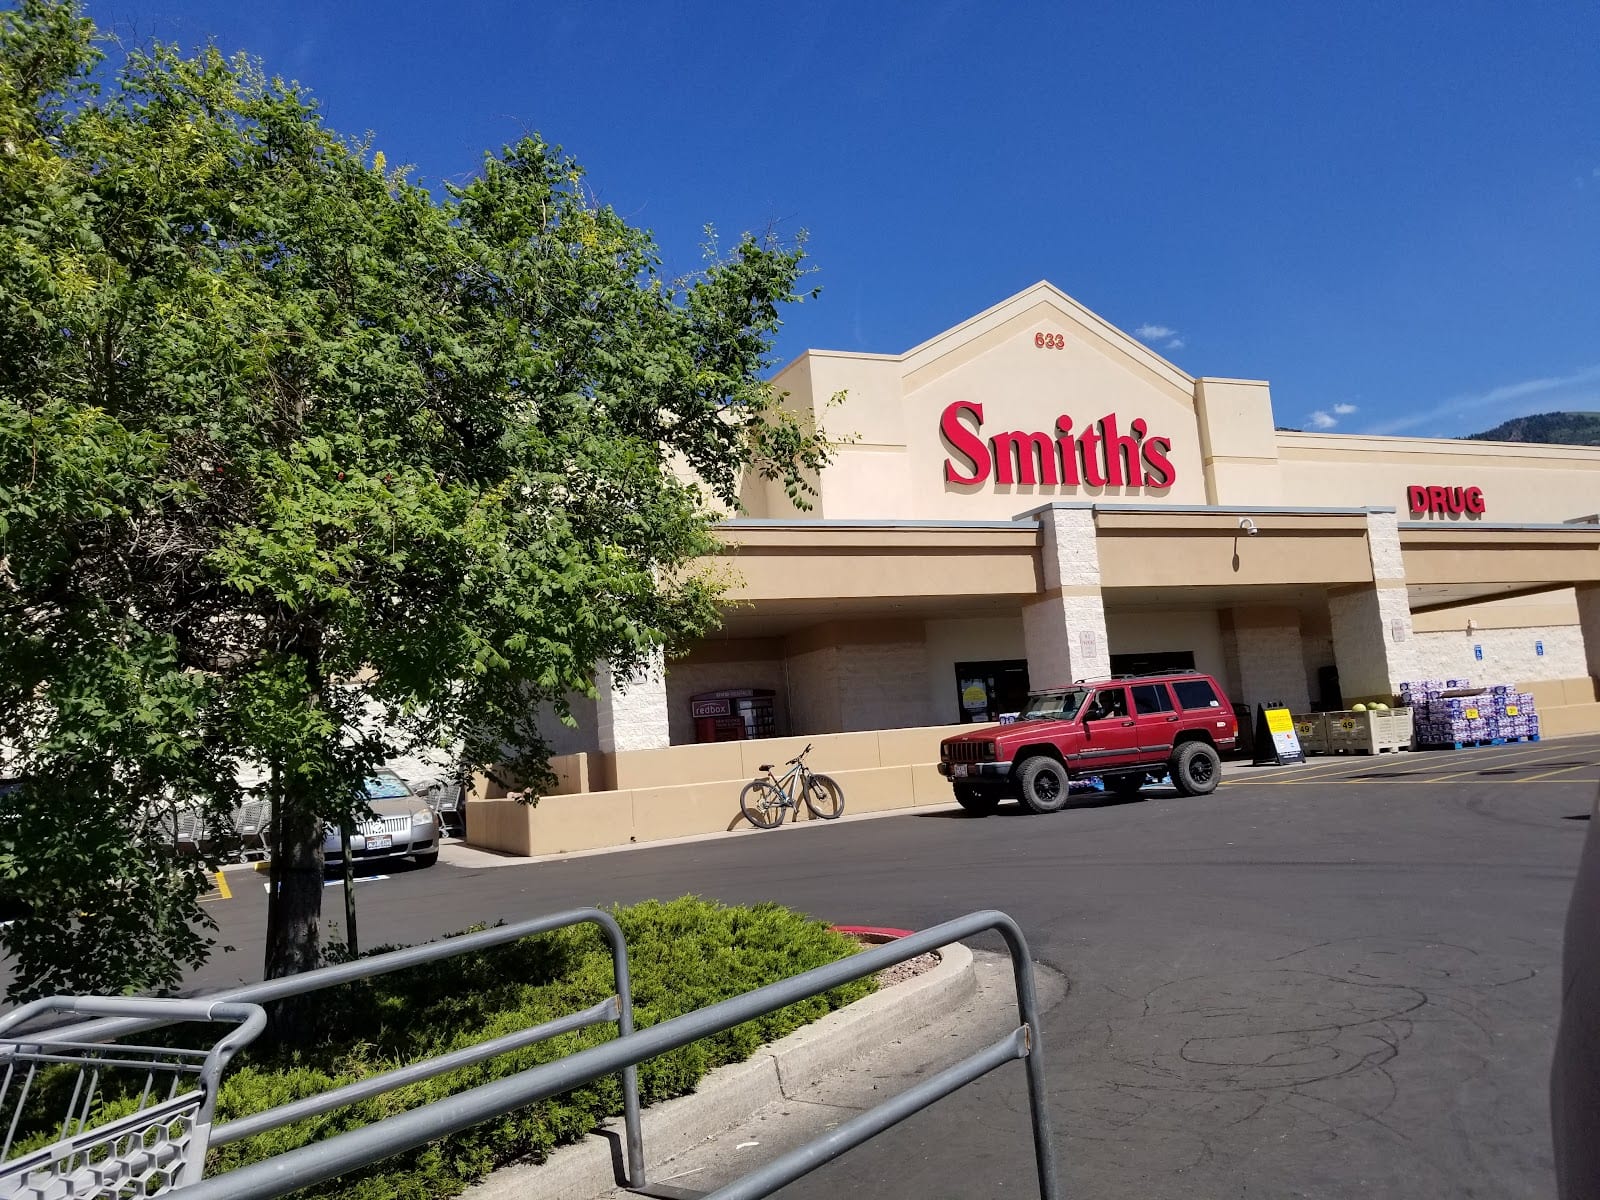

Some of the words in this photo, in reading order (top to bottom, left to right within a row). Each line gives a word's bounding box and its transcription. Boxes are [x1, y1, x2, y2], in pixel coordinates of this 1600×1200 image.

[1034, 332, 1065, 349] 633
[939, 400, 1176, 488] Smith's
[1407, 485, 1486, 513] DRUG
[696, 704, 726, 714] redbox
